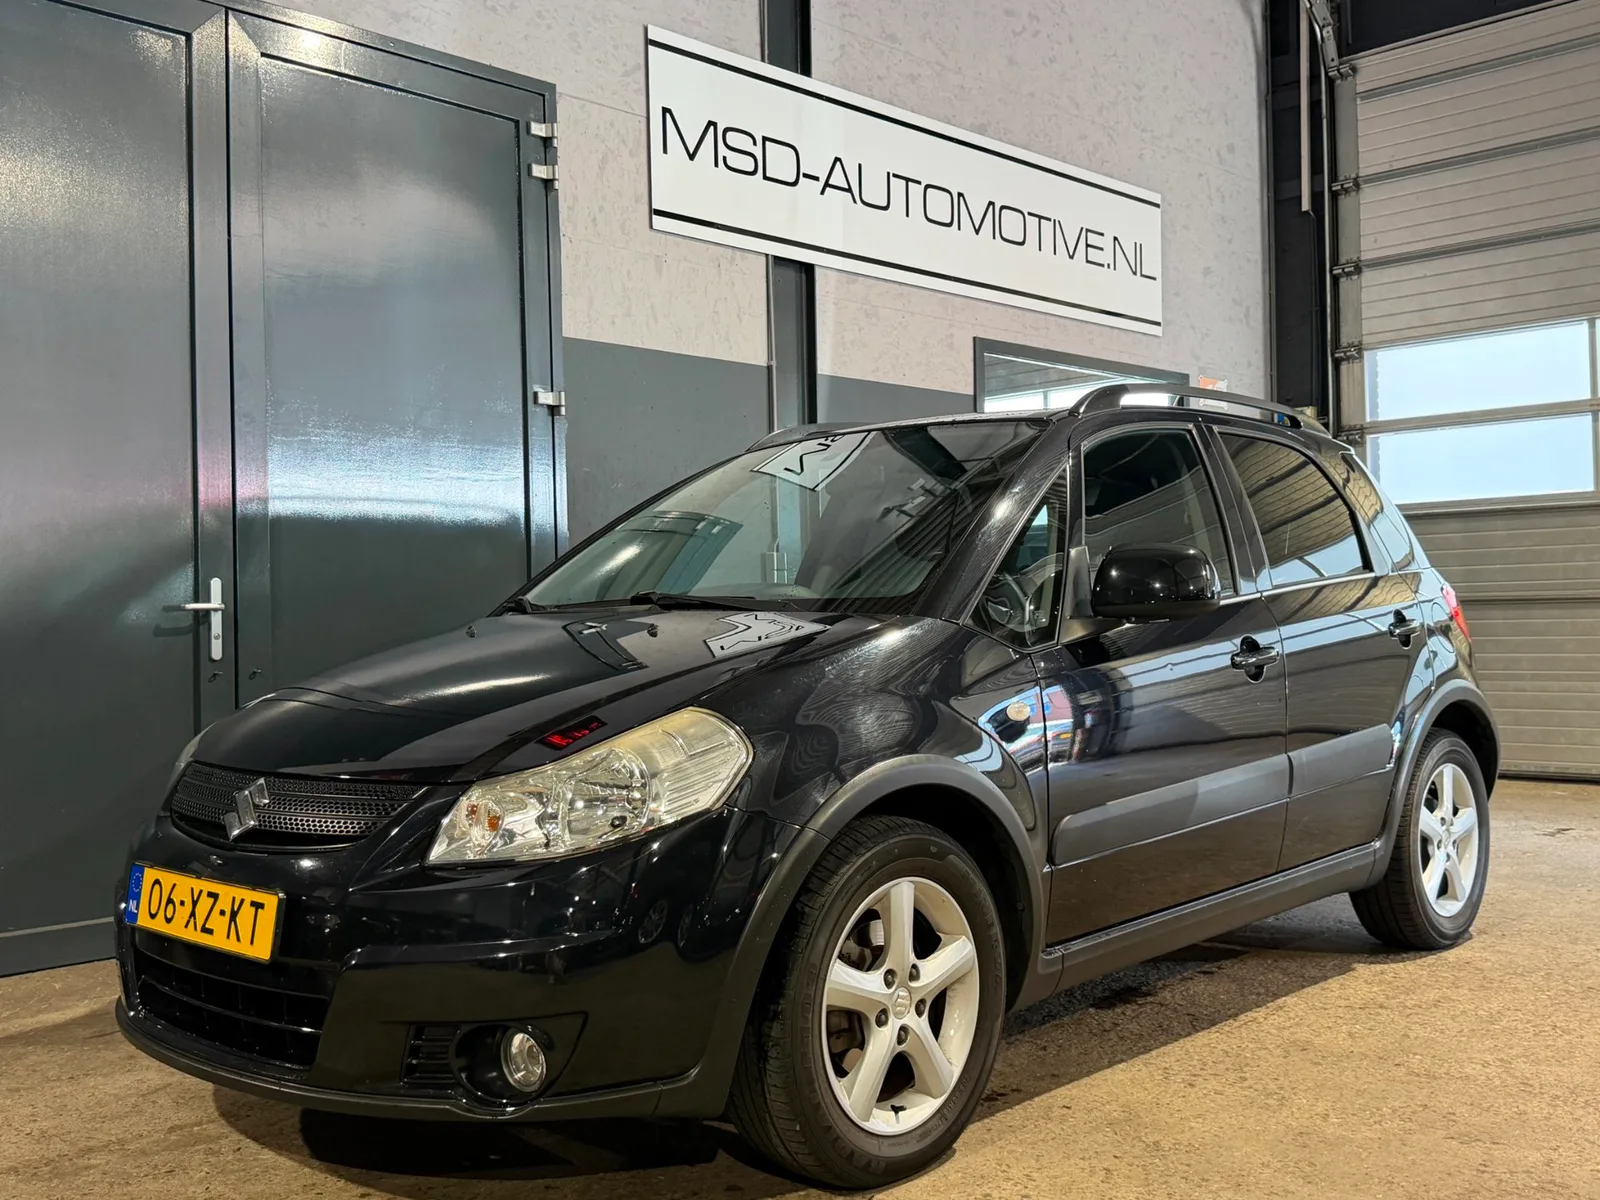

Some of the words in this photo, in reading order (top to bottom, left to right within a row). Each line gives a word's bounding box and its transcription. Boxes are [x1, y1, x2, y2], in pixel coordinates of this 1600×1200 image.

[662, 106, 1157, 281] MSD-AUTOMOTIVE.NL
[128, 899, 138, 913] NL
[148, 878, 265, 945] 06-XZ-KT
